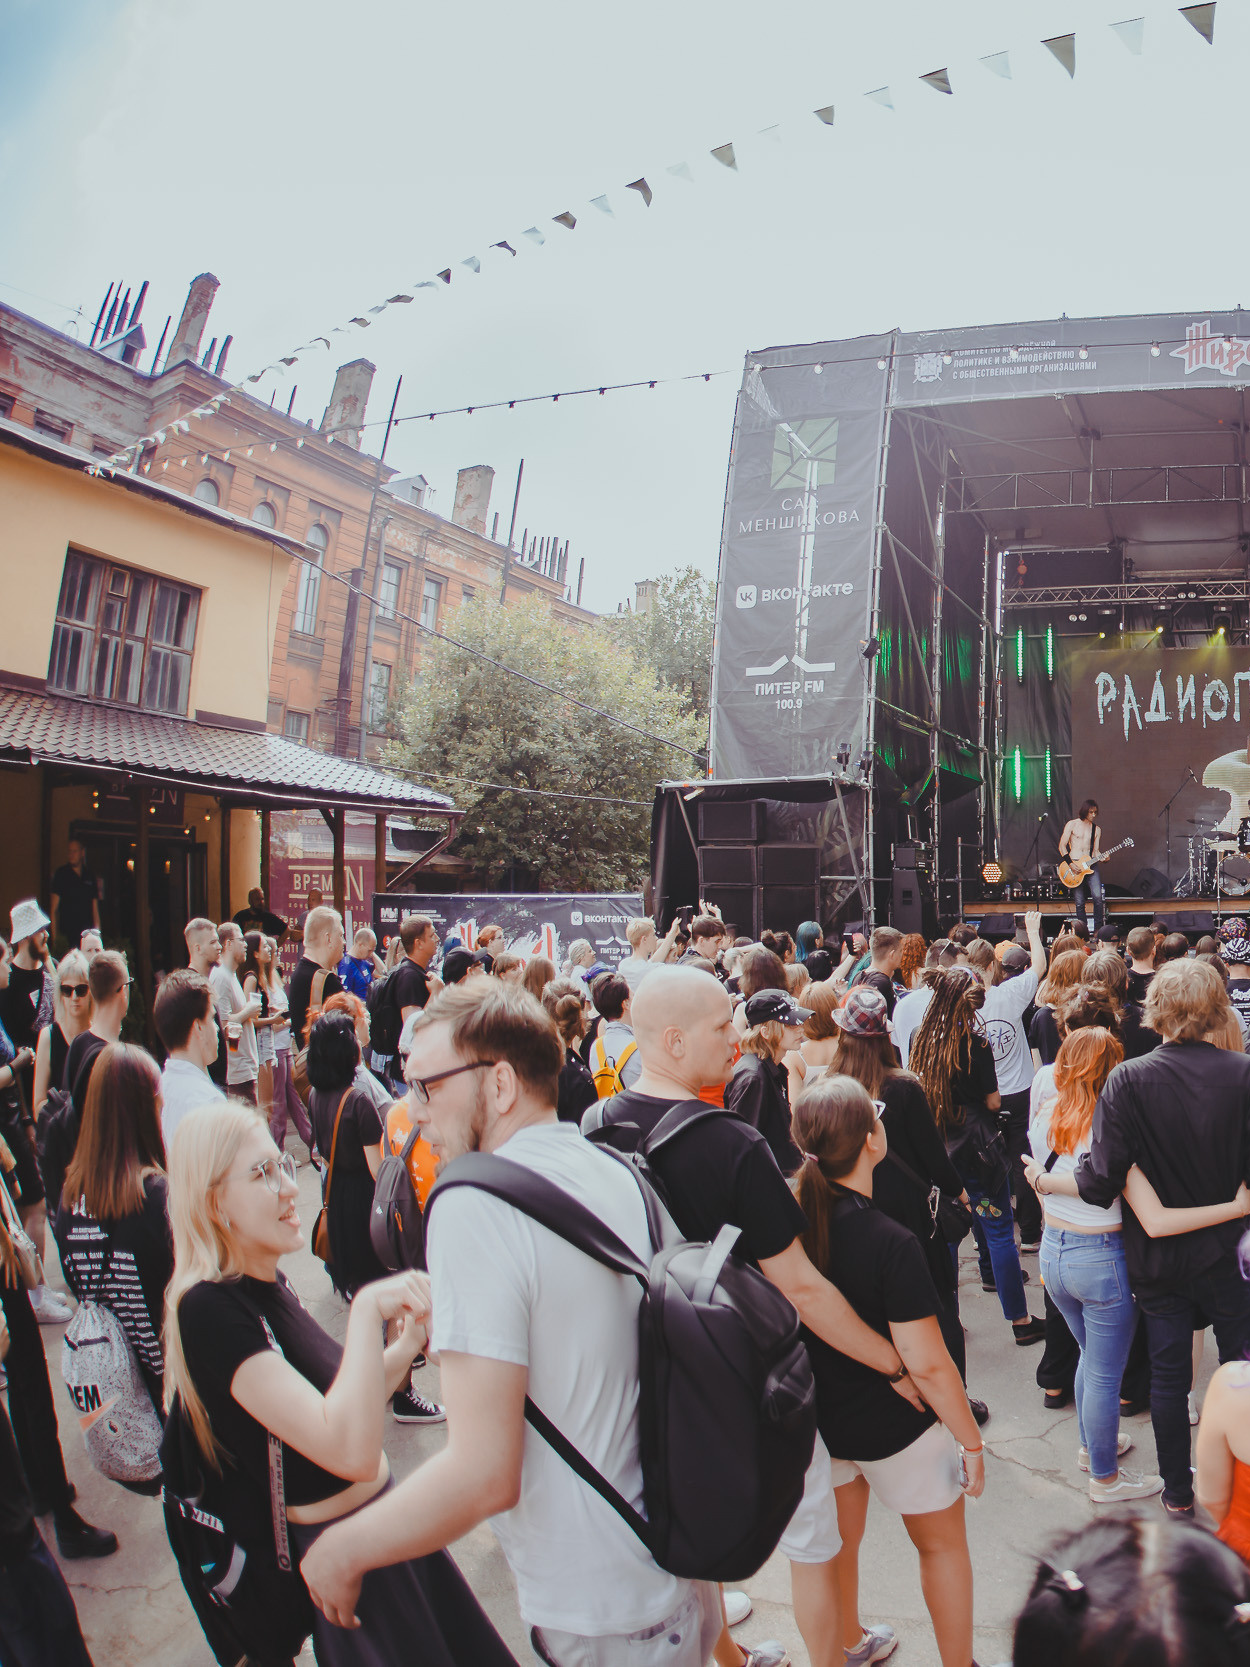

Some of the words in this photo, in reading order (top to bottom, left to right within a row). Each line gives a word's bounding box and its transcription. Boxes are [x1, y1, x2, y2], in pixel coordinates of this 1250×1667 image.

[953, 356, 992, 368] ПОЛИТИКЕ
[994, 355, 1000, 364] И
[952, 371, 958, 379] С
[959, 365, 1028, 379] ОБЩЕСТВЕННЫМИ
[1030, 361, 1097, 374] ОРГАНИЗАЦИЯМИ
[755, 680, 801, 696] ПИТЕР
[804, 679, 825, 694] FM
[775, 698, 803, 711] 100.9
